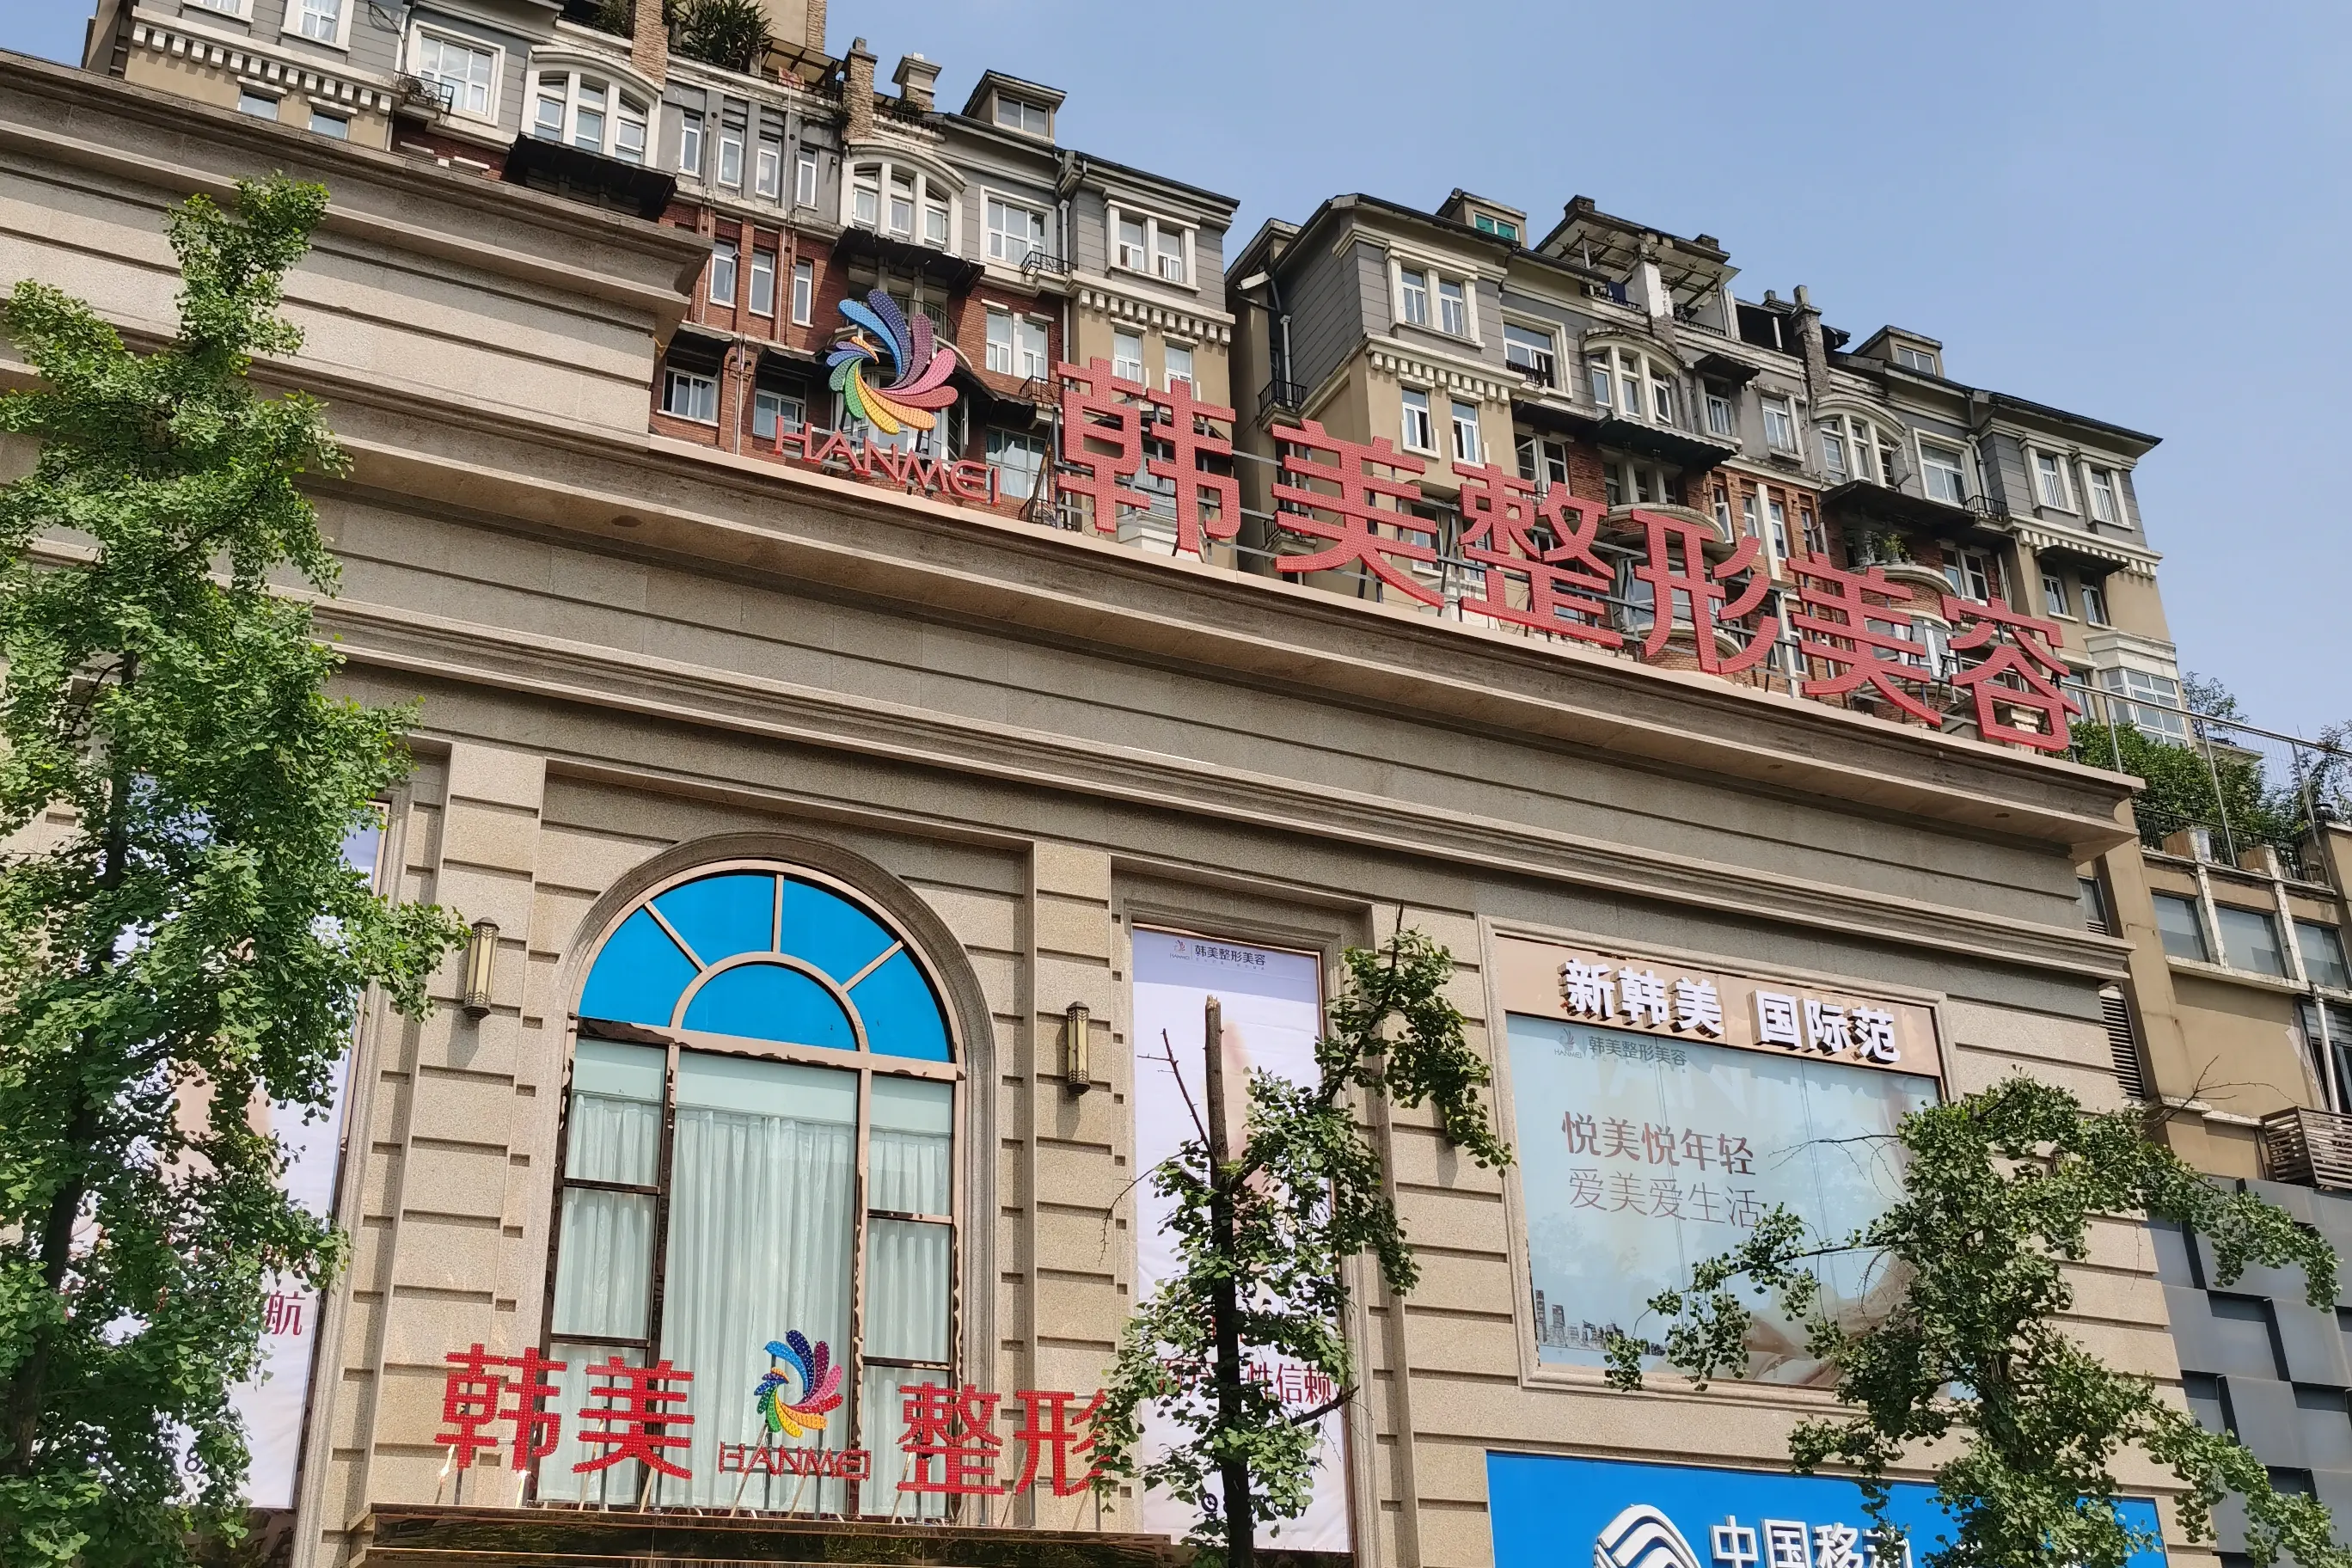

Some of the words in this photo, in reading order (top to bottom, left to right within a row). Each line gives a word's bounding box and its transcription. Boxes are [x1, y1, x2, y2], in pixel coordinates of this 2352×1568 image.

[775, 415, 1001, 507] HANMEI
[1057, 356, 2081, 751] 韩美整形美容
[1194, 945, 1265, 965] 韩美整形美容
[1560, 959, 1724, 1036] 新韩美
[1750, 989, 1901, 1063] 国际范
[1589, 1036, 1687, 1067] 韩美整形美容
[1562, 1111, 1756, 1176] 悦美悦年轻
[1569, 1168, 1761, 1228] 爱美爱生活
[435, 1343, 695, 1479] 韩美
[896, 1381, 1112, 1498] 整形
[719, 1440, 872, 1480] HANMEI
